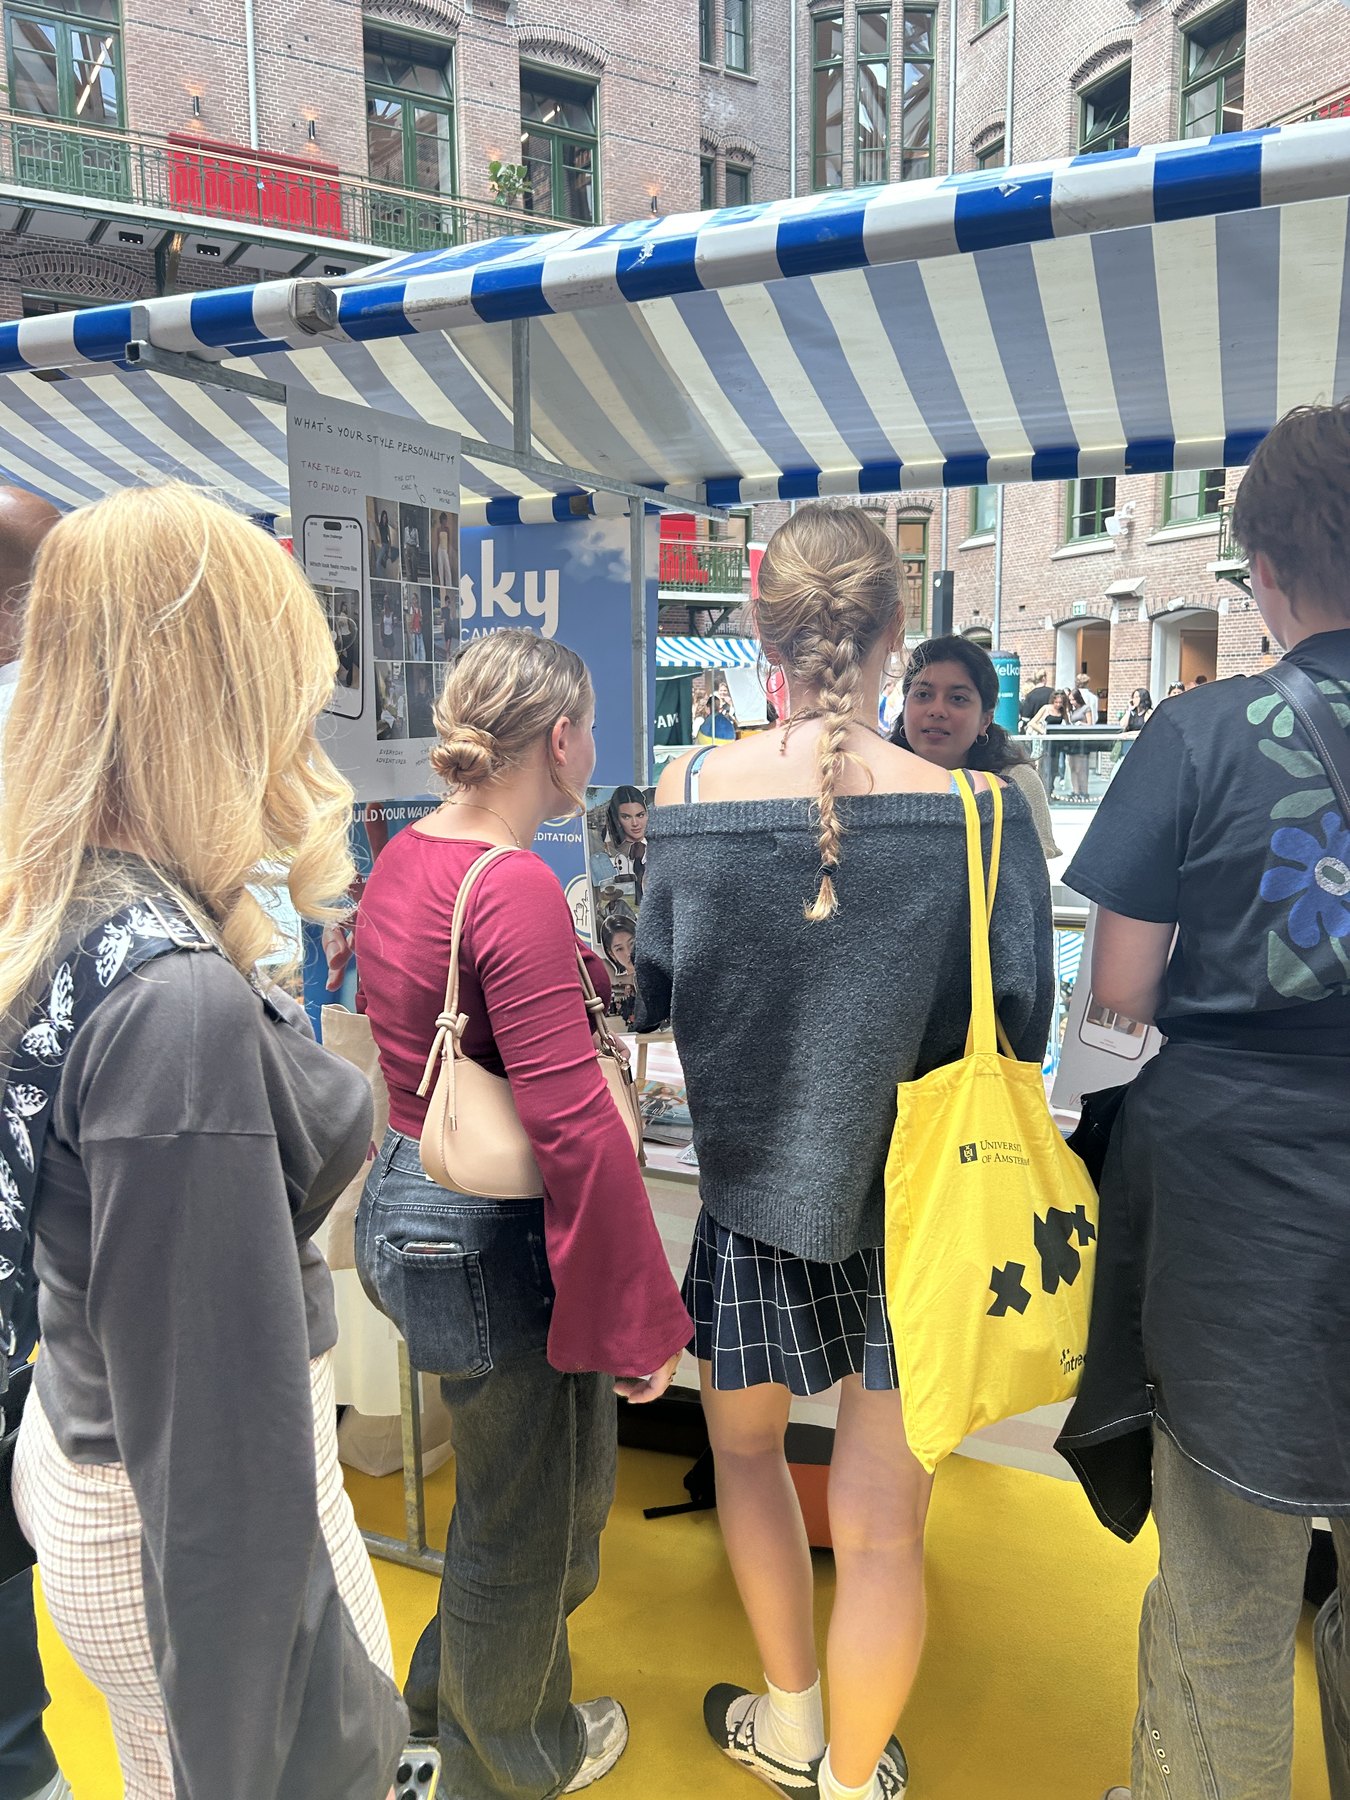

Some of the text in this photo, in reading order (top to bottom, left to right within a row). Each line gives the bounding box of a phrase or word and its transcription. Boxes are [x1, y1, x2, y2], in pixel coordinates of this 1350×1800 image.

[294, 416, 455, 465] WHAT'S YOUR STYLE PERSONALITY?
[301, 460, 362, 478] TAKE THE QUIZ
[307, 480, 358, 495] TO FIND OUT
[353, 808, 379, 823] UILD
[379, 807, 406, 821] YOUR
